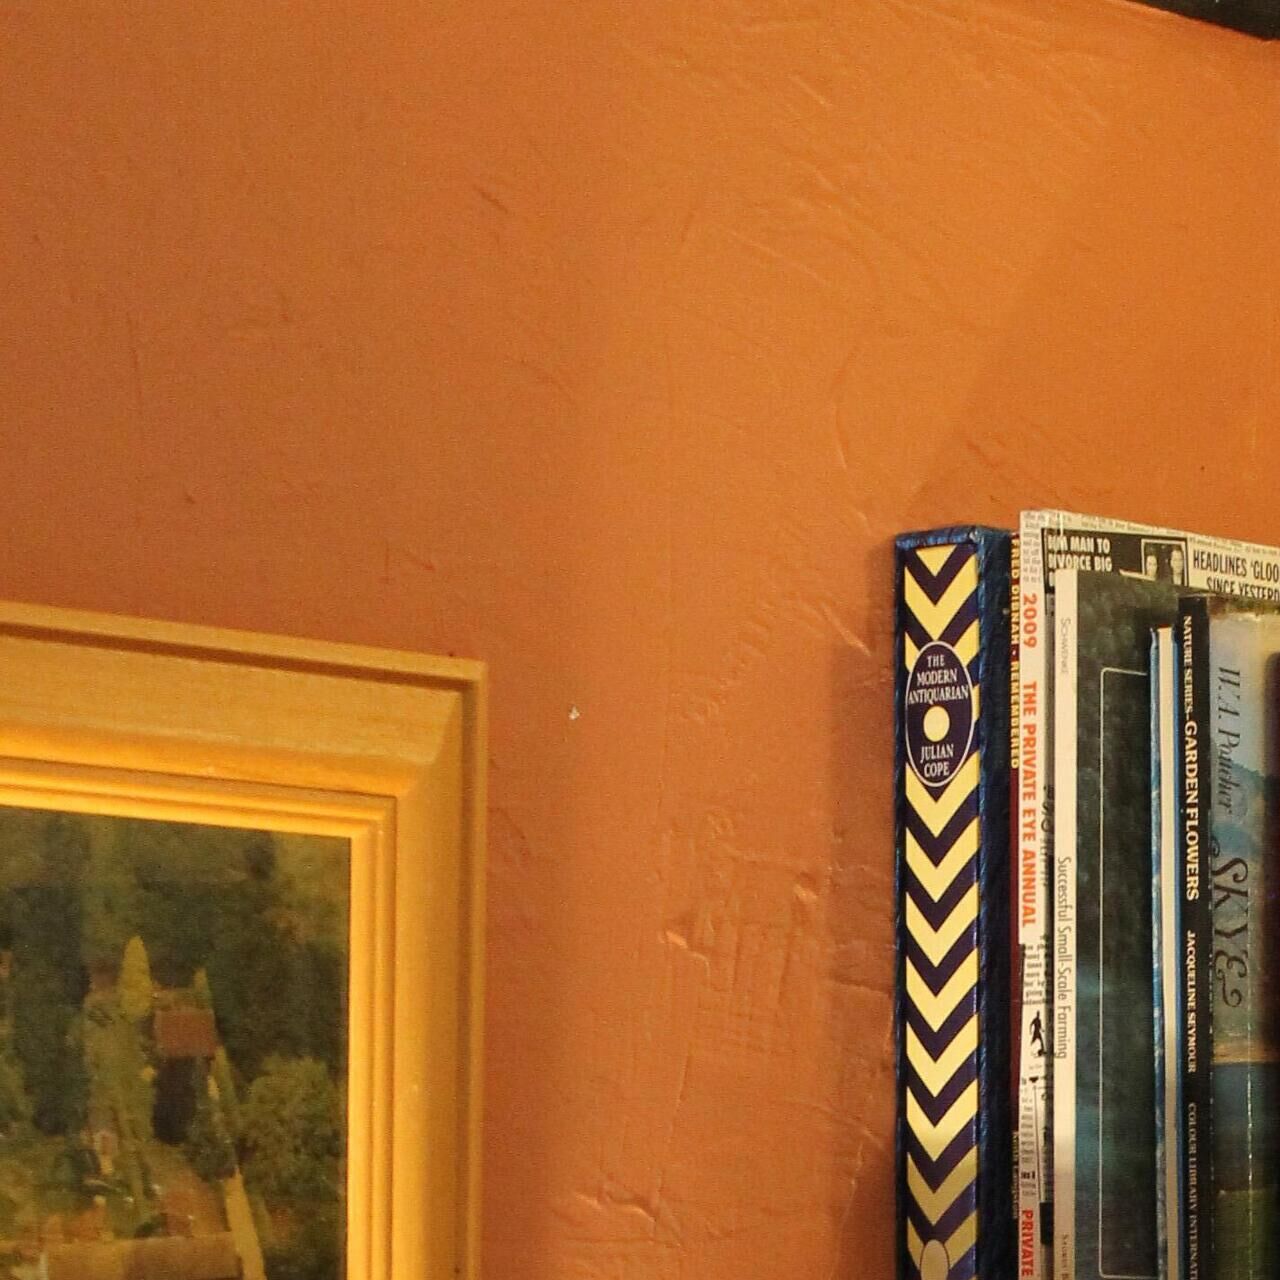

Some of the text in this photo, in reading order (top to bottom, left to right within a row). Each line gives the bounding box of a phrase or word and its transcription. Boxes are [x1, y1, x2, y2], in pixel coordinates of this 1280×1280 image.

[1011, 538, 1020, 578] FRED
[1070, 535, 1094, 552] MAN
[1097, 537, 1111, 554] TO
[1193, 550, 1247, 578] HEADLINES
[1207, 577, 1235, 594] SINCE
[1023, 593, 1037, 648] 2009
[916, 668, 957, 687] MODERN
[926, 655, 944, 668] THE
[908, 683, 969, 706] ANTIQUARIAN
[1023, 681, 1037, 716] THE
[920, 743, 954, 763] JULIAN
[924, 760, 951, 777] COPE
[1023, 724, 1037, 801] PRIVATE
[1184, 616, 1199, 901] NATURE GARDEN FLOWERS
[1022, 809, 1036, 841] EYE
[1022, 849, 1037, 926] ANNUAL
[1054, 857, 1073, 1059] Successful Small-Scale Farming
[1021, 1210, 1034, 1276] PRIVATE
